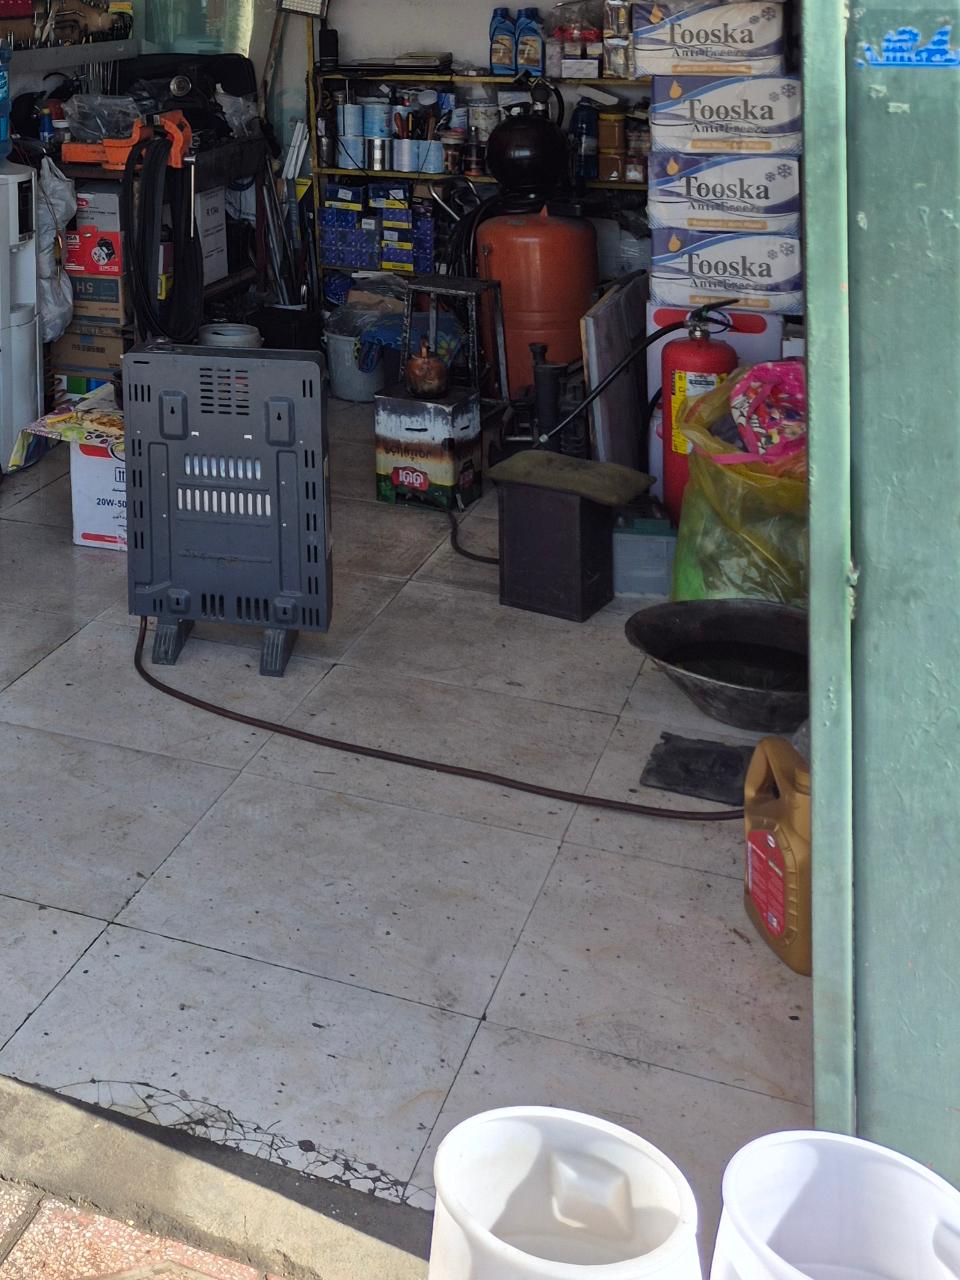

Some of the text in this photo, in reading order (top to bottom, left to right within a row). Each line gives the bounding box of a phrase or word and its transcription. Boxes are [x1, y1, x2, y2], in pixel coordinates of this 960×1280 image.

[669, 22, 755, 44] Tooska
[683, 99, 774, 120] Tooska
[680, 176, 770, 200] Tooska
[682, 253, 772, 278] Tooska
[96, 497, 127, 509] 20W-50
